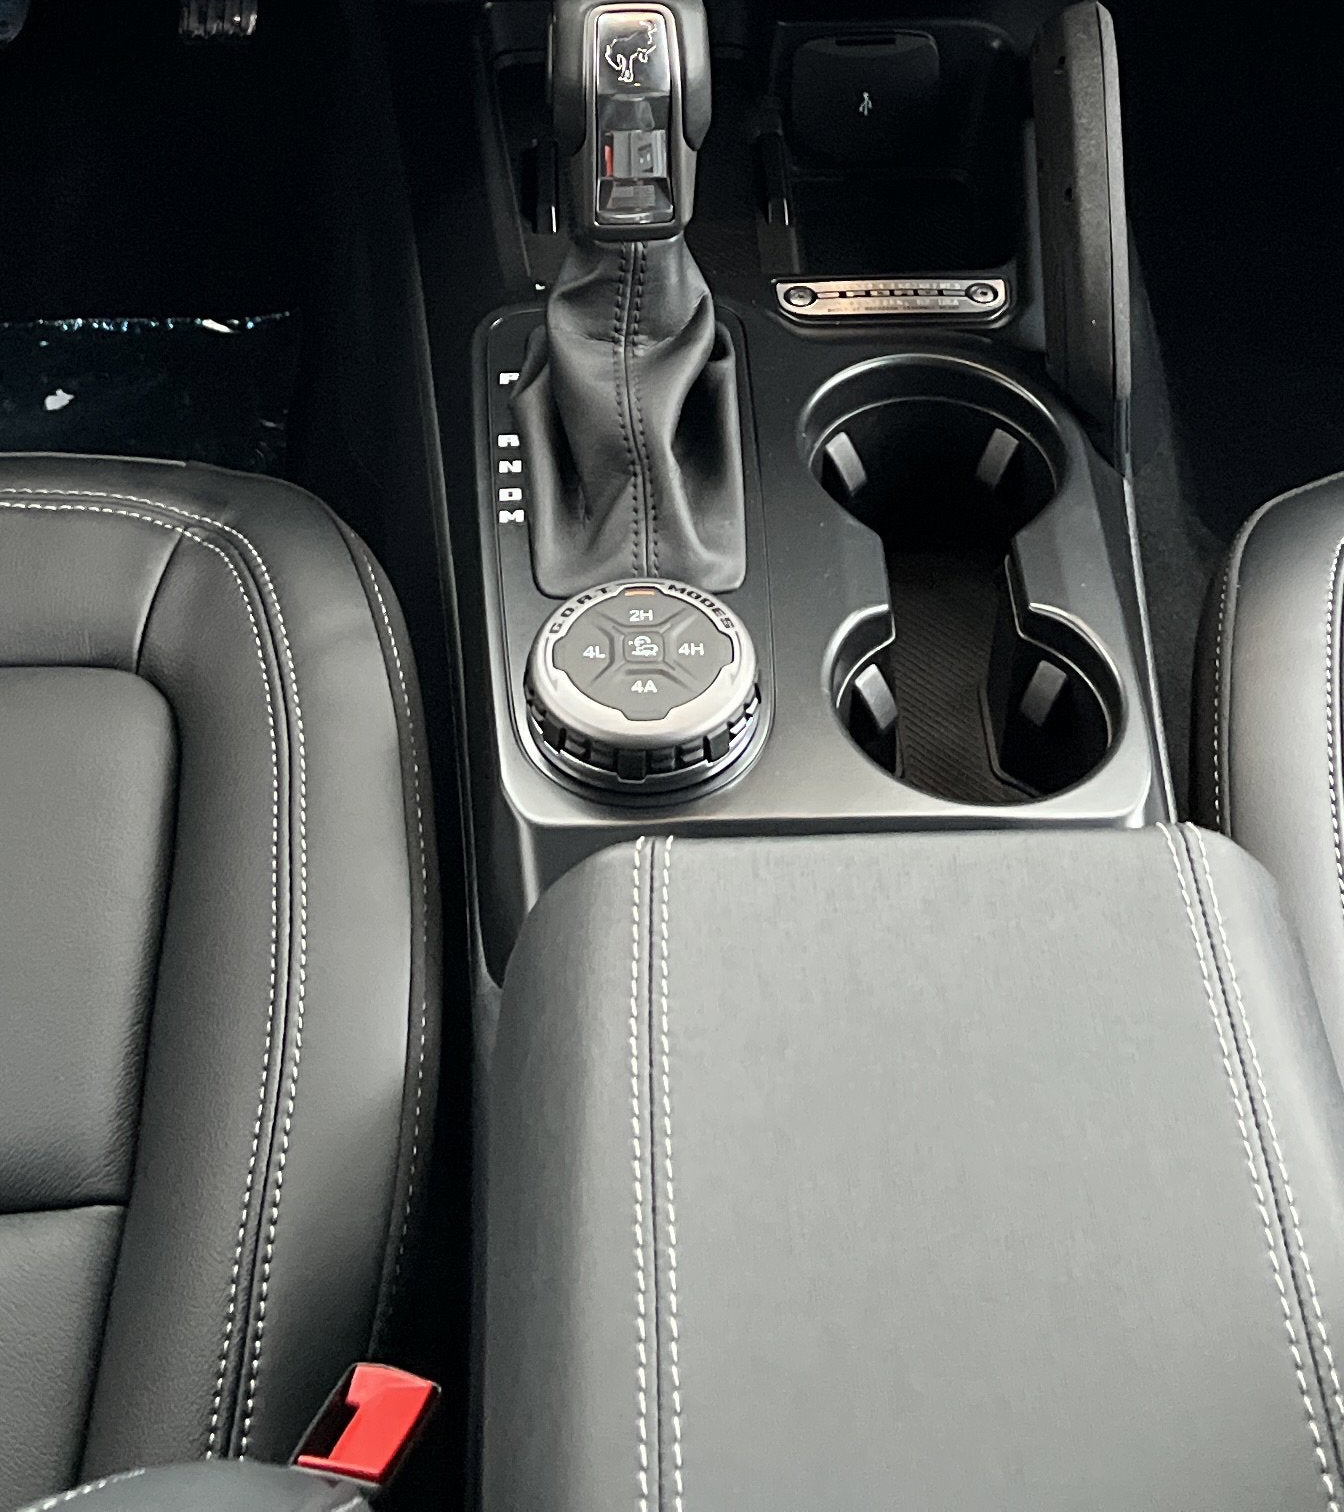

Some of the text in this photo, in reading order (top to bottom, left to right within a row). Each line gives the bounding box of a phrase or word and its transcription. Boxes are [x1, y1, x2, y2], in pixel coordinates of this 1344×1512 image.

[499, 372, 520, 385] P
[498, 459, 523, 474] N
[498, 488, 523, 502] D
[498, 509, 525, 524] M
[667, 584, 735, 629] MODES
[629, 609, 654, 622] 2H
[582, 645, 606, 659] 4L
[678, 643, 705, 657] 4H
[630, 679, 658, 694] 4A
